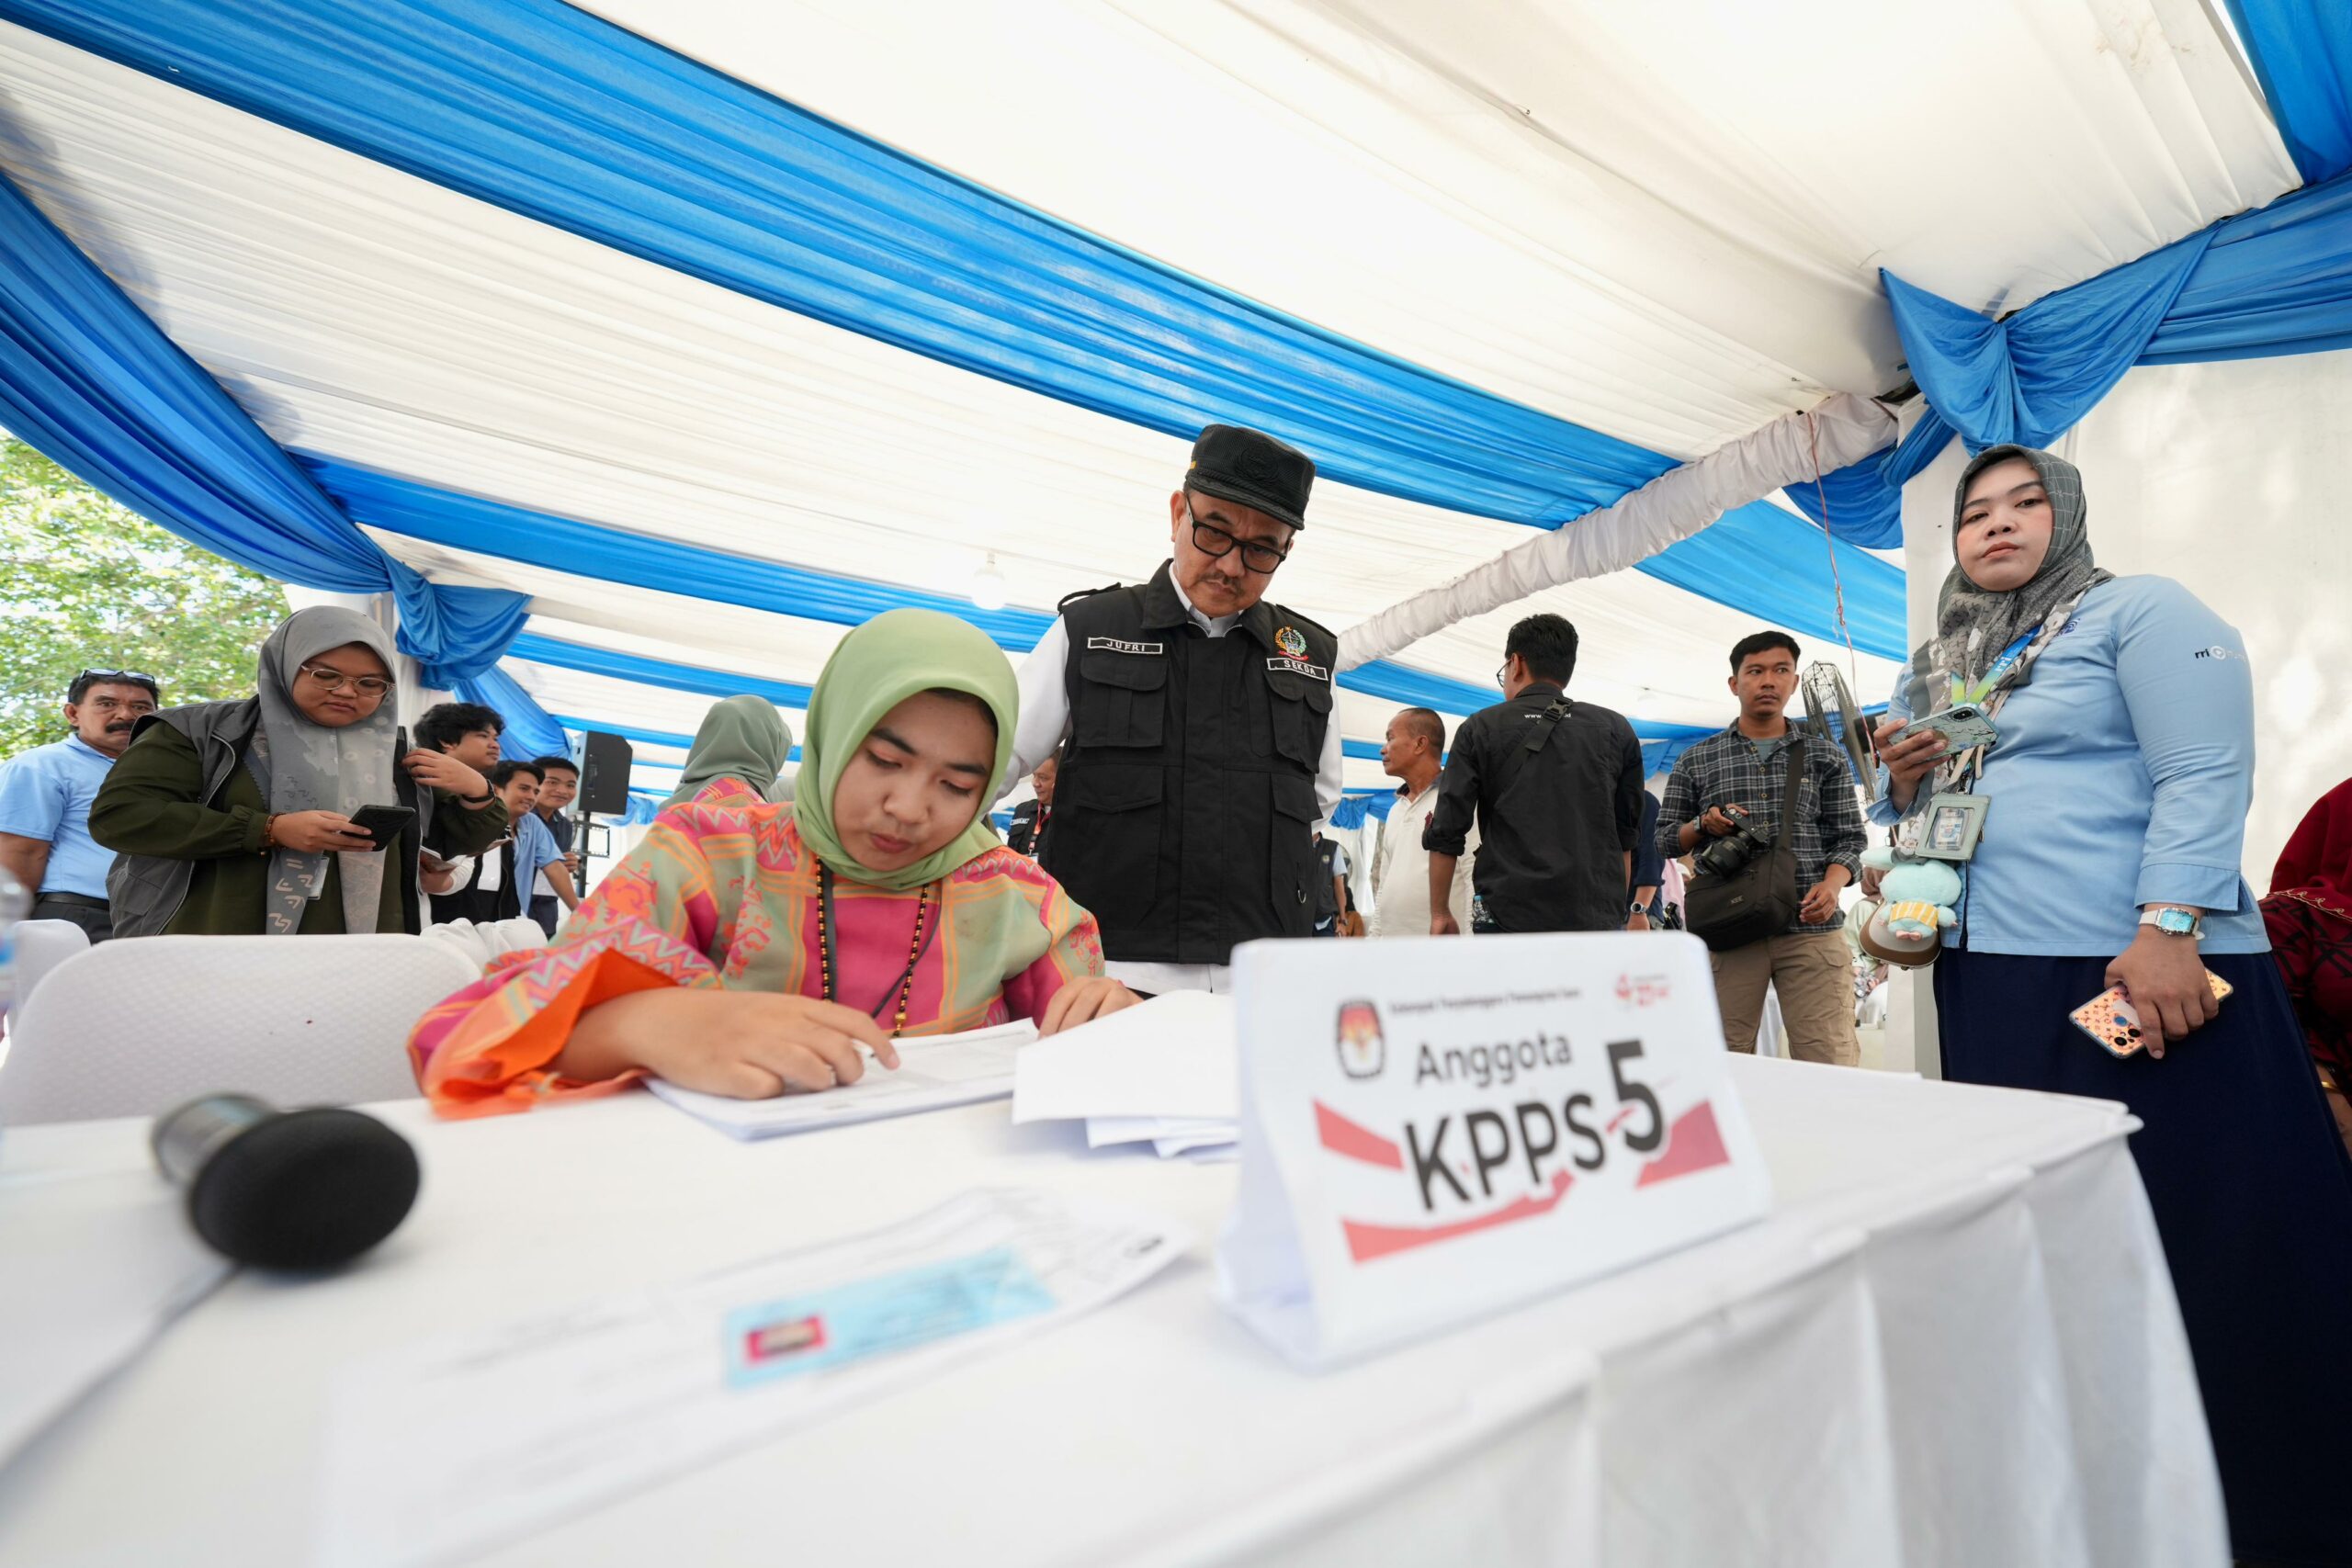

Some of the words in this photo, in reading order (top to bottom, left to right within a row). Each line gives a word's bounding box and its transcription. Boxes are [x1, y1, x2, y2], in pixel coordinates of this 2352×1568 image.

[1105, 640, 1146, 653] JUFRI
[2194, 648, 2211, 660] rri
[1283, 659, 1317, 676] SEKDA
[1415, 1032, 1572, 1089] Anggota
[1404, 1091, 1605, 1212] KPPS
[1604, 1039, 1665, 1154] 5
